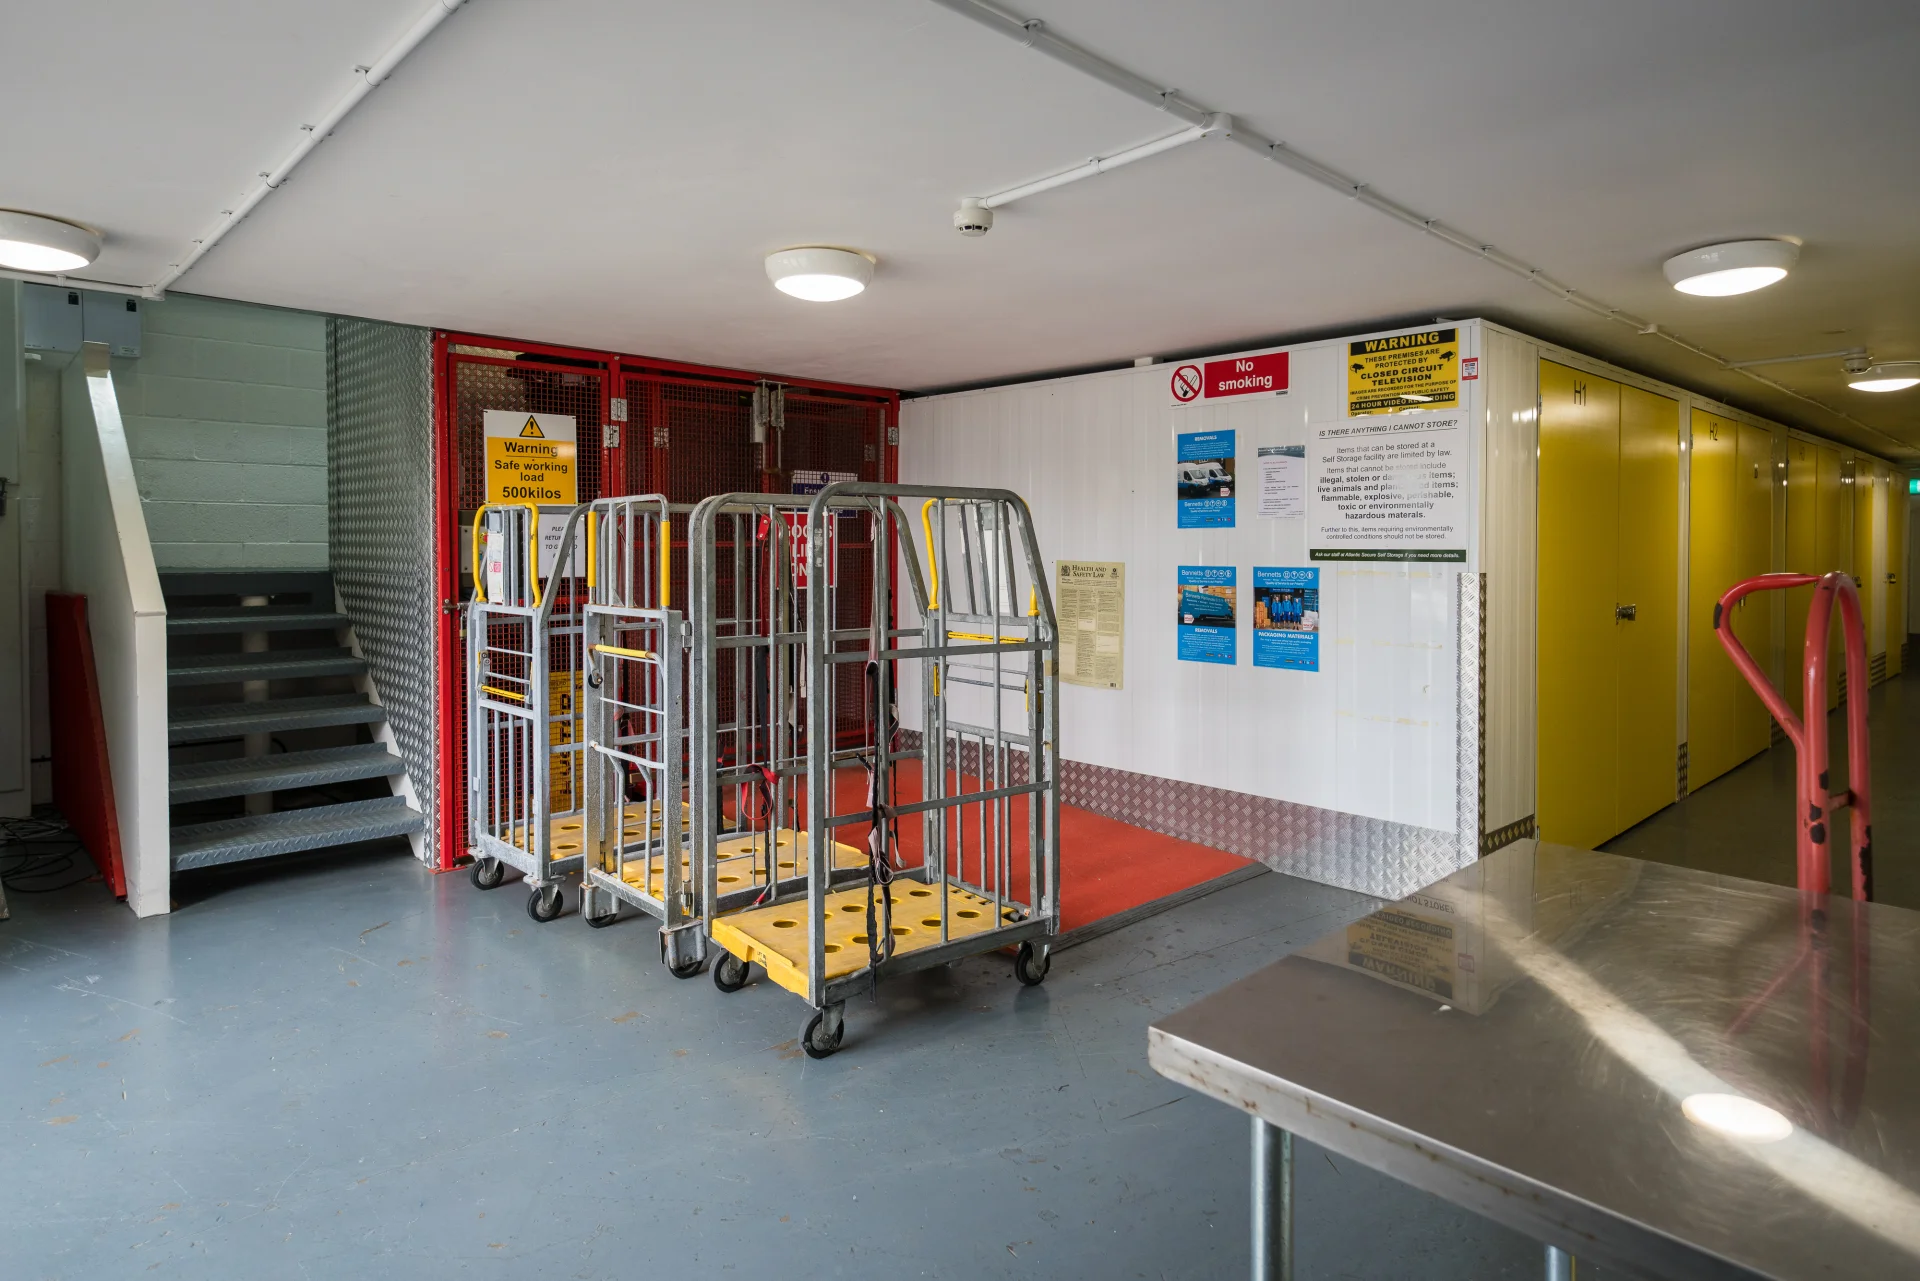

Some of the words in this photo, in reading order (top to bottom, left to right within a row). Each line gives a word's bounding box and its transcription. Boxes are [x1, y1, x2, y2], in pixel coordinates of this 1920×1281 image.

[1364, 332, 1440, 352] WARNING
[1388, 350, 1424, 360] PREMISES
[1236, 360, 1254, 372] No
[1375, 359, 1416, 368] PROTECTED
[1361, 369, 1398, 380] CLOSED
[1402, 364, 1444, 374] CIRCUIT
[1218, 374, 1272, 391] smoking
[1372, 374, 1432, 386] TELEVISION
[1384, 398, 1406, 406] VIDEO
[1408, 393, 1455, 404] RECRDING
[1574, 380, 1587, 406] H1
[1351, 426, 1387, 434] ANYTHING
[1393, 422, 1425, 431] CANNOT
[1426, 420, 1458, 428] STORE?
[1710, 421, 1718, 441] H2
[504, 442, 558, 457] Warning
[1336, 454, 1362, 463] Storage
[1401, 451, 1424, 459] limited
[494, 460, 520, 470] Safe
[524, 462, 568, 474] working
[520, 472, 544, 482] load
[502, 486, 561, 499] 500kilos
[1364, 493, 1404, 501] explosive,
[1407, 491, 1454, 500] perishable,
[1368, 501, 1434, 510] environmentally
